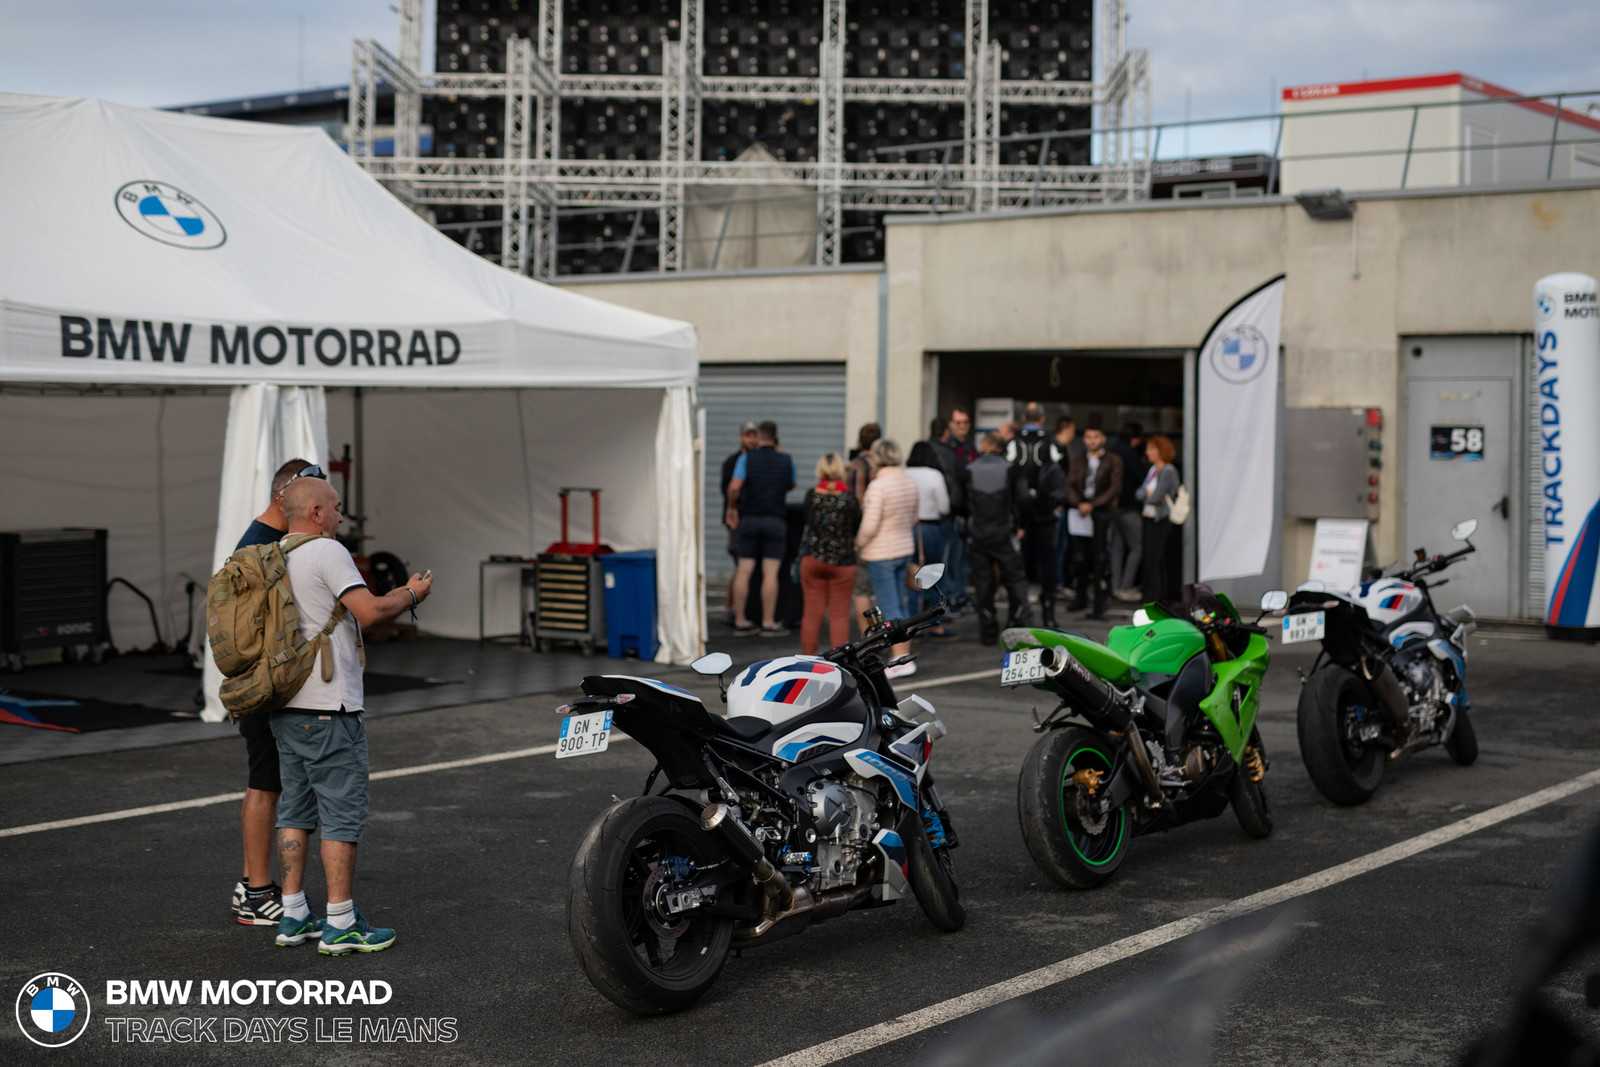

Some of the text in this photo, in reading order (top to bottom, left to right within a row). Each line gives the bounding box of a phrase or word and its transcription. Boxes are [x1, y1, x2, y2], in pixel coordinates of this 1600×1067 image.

[122, 184, 193, 205] BMW
[1564, 292, 1597, 303] BMW
[60, 315, 461, 366] BMW MOTORRAD
[1450, 428, 1483, 453] 58
[1538, 331, 1565, 548] TRACKDAYS
[1015, 652, 1028, 665] DS
[574, 719, 591, 735] GN
